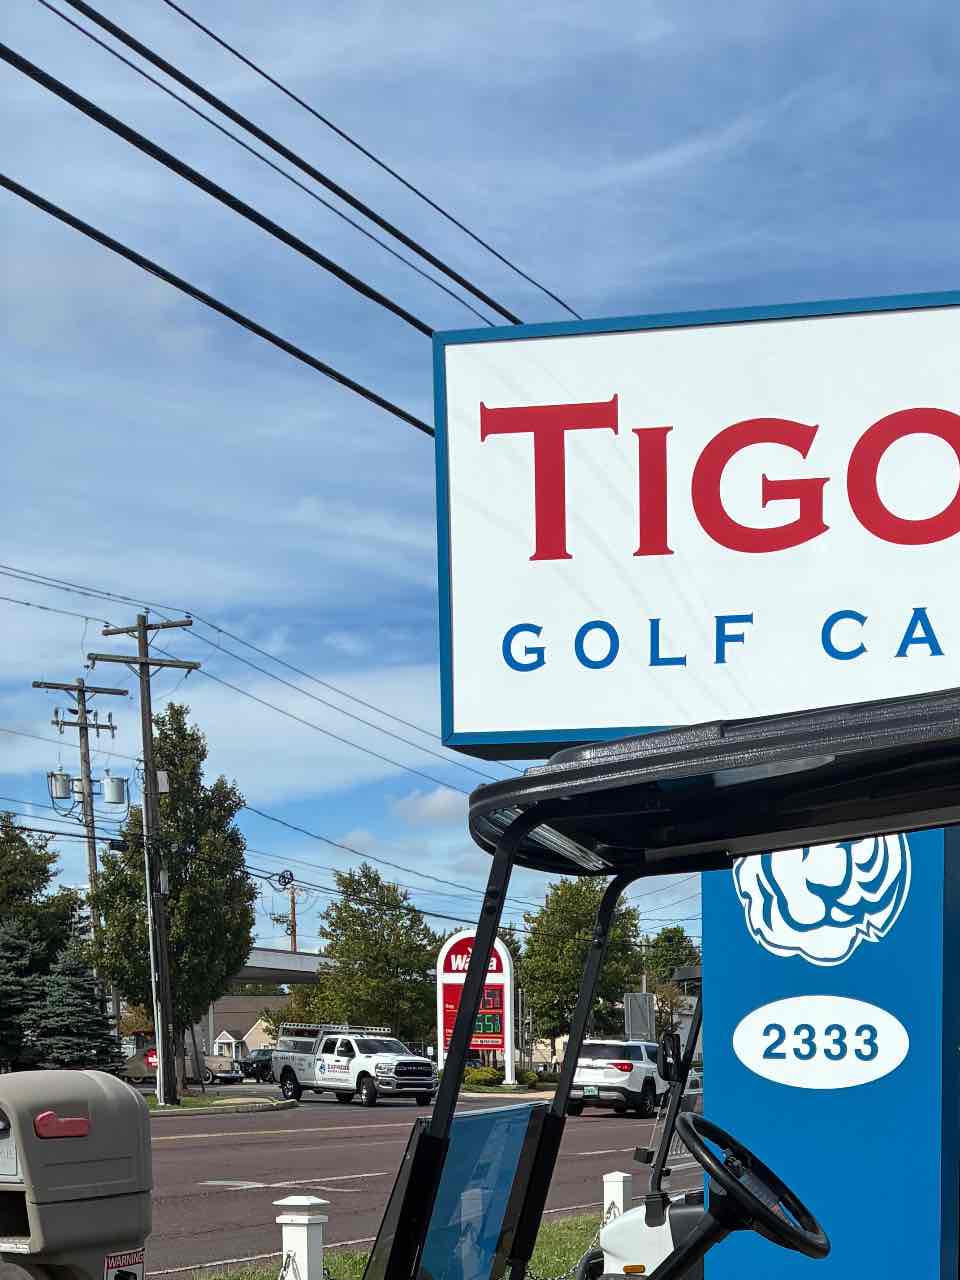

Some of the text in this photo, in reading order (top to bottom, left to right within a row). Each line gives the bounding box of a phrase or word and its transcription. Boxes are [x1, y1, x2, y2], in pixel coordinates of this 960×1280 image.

[501, 612, 754, 672] GOLF
[450, 954, 497, 971] Waa
[762, 1023, 879, 1062] 2333
[108, 1251, 145, 1267] WARNING
